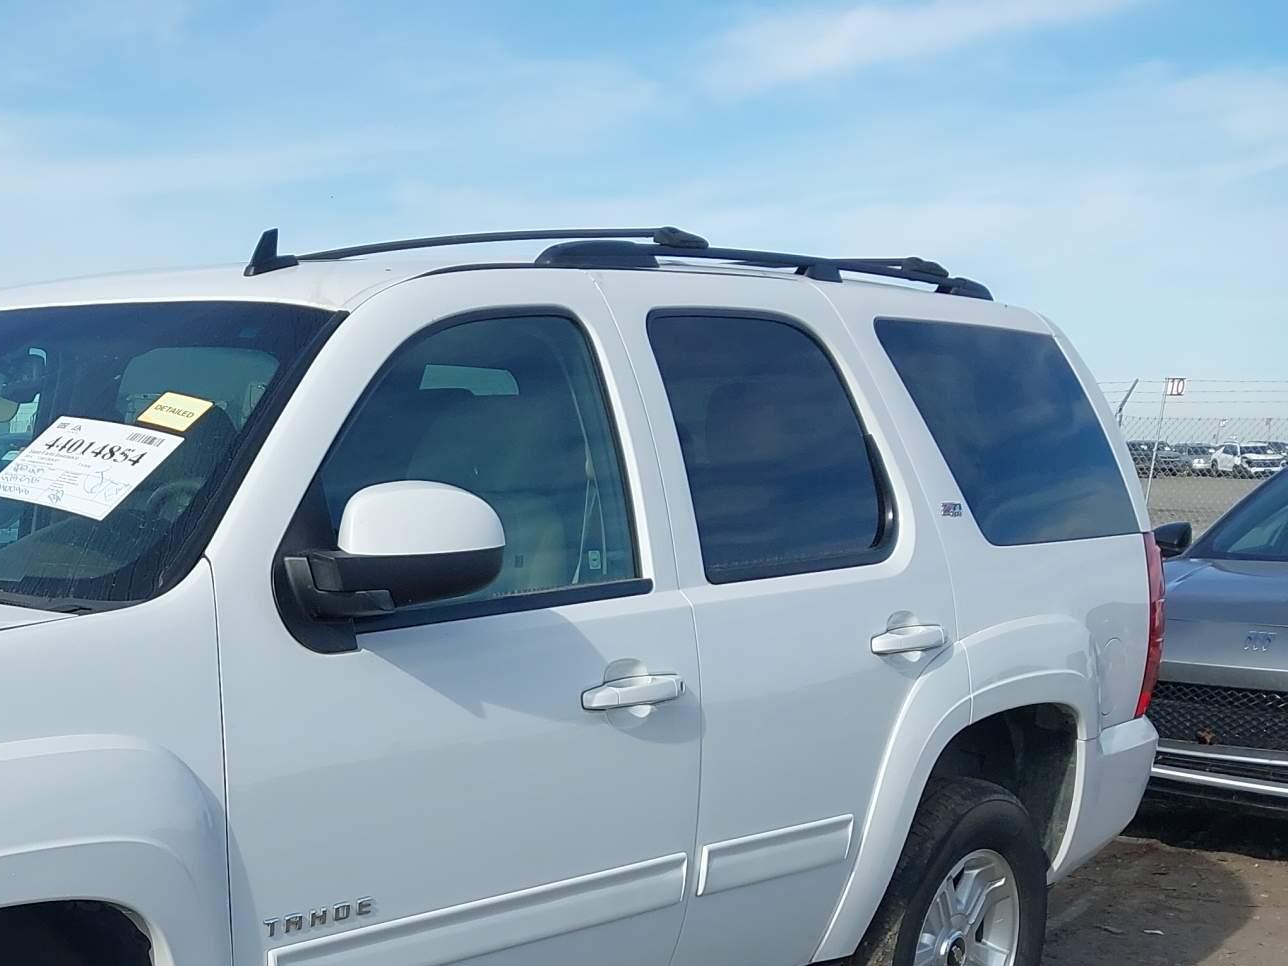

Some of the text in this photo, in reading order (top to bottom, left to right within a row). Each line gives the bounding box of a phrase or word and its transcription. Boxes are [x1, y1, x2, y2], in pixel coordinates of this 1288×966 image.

[154, 404, 195, 418] DETAILED
[45, 435, 148, 467] 44014854
[263, 896, 374, 937] TAHOE
